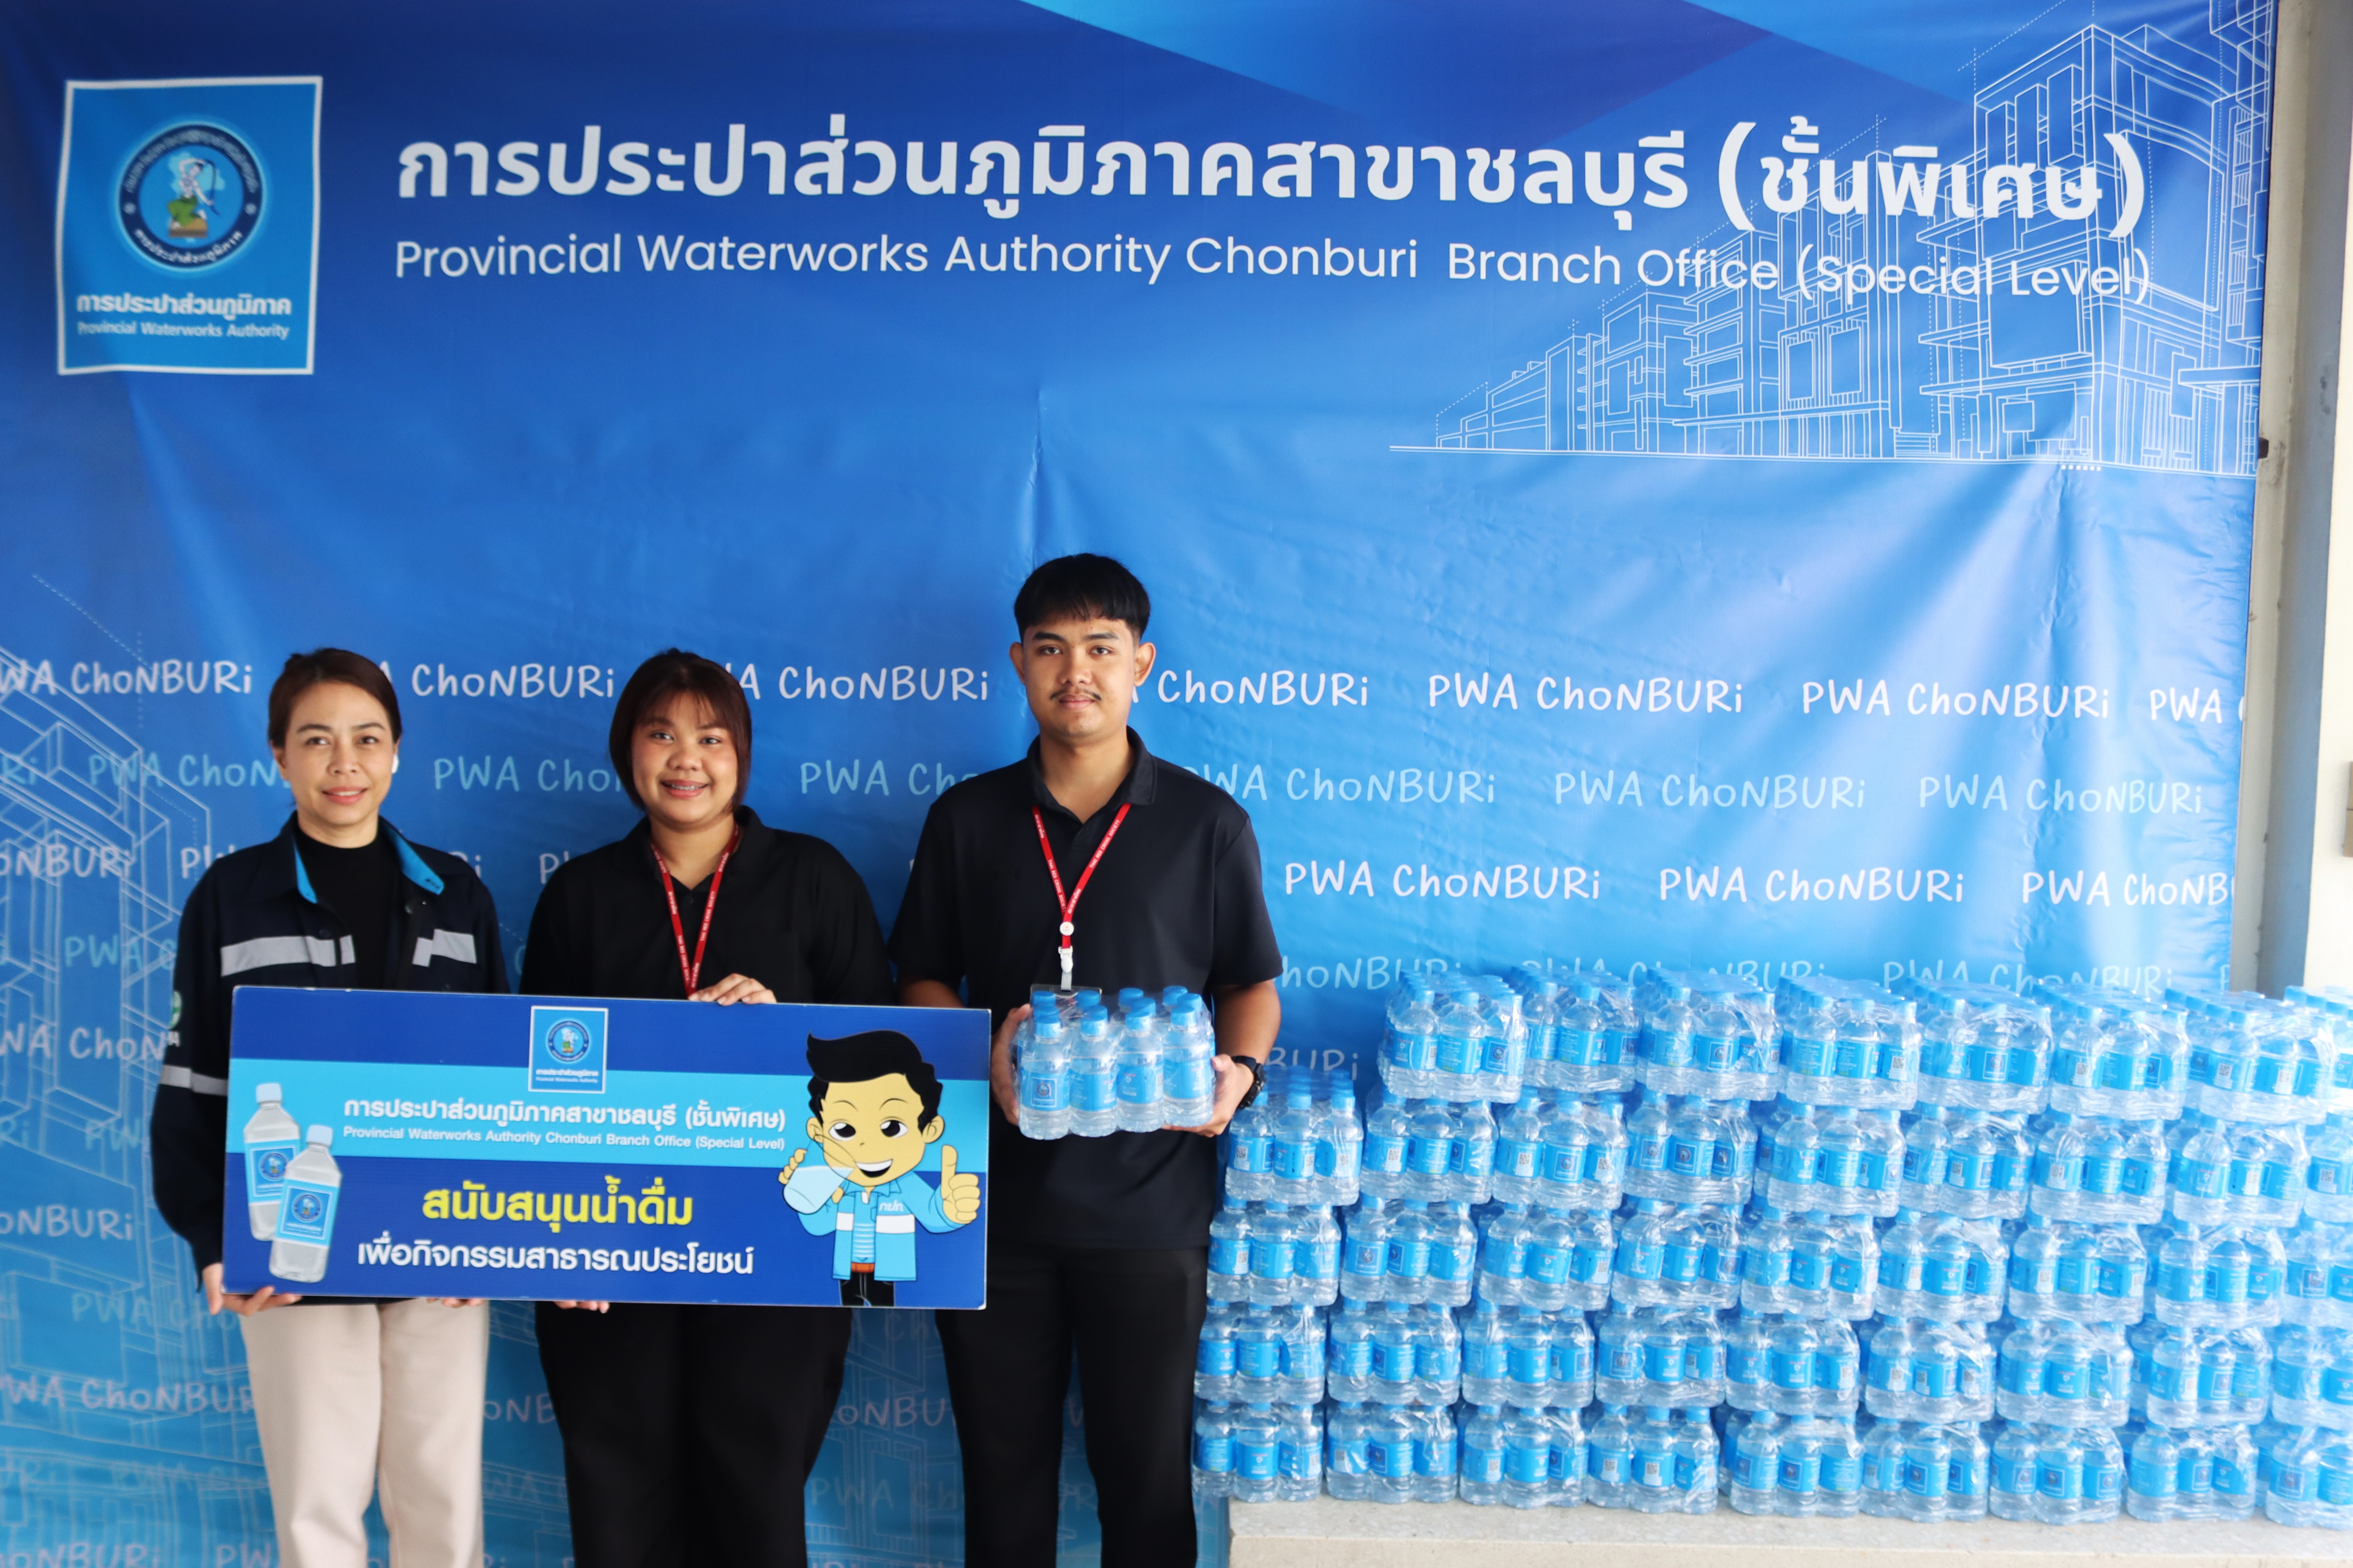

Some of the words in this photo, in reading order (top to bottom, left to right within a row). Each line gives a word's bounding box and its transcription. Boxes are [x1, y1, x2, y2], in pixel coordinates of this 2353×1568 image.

[398, 114, 1688, 231] การประปาส่วนภูมิภาคสาขาชลบุรี
[1718, 115, 2145, 239] (ชั้นพิเศษ)
[396, 232, 622, 279] Provincial
[637, 234, 928, 273] Waterworks
[943, 234, 1171, 285] Authority
[1186, 236, 1418, 279] Chonburi
[1449, 242, 1621, 285] Branch
[1638, 248, 1779, 291] Office
[1798, 243, 1993, 306] (Special
[2011, 248, 2150, 305] Level)
[77, 292, 292, 321] การประปาส่วนภูมิภาค
[77, 320, 137, 335] Provincial
[140, 321, 223, 337] Waterworks
[226, 323, 290, 340] Authority
[0, 658, 57, 696] WA
[71, 659, 253, 694] ChoNBURi
[412, 663, 614, 698] ChoNBURi
[779, 665, 988, 701] ChoNBURi
[1157, 669, 1368, 706] ChoNBURi
[1429, 672, 1518, 710] PWA
[1536, 676, 1743, 714] ChoNBURi
[1802, 678, 1891, 716] PWA
[1907, 682, 2109, 718] ChoNBURi
[2150, 687, 2222, 724] PWA
[88, 751, 163, 787] PWA
[178, 754, 291, 789] ChoN
[434, 755, 520, 791] PWA
[800, 759, 890, 796] PWA
[1184, 763, 1267, 802] WA
[1286, 768, 1495, 804] ChoNBURi
[1555, 770, 1643, 807] PWA
[1661, 774, 1866, 809] ChoNBURi
[1920, 774, 2008, 811] PWA
[2026, 778, 2202, 814] ChoNBURi
[1108, 819, 1120, 837] SOCIETY
[1285, 860, 1374, 897] PWA
[1393, 864, 1600, 900] ChoNBURi
[1659, 866, 1748, 902] PWA
[1765, 868, 1964, 902] ChoNBURi
[2023, 870, 2110, 907] PWA
[2124, 872, 2234, 906] ChoNB
[64, 935, 145, 971] PWA
[1281, 955, 1461, 990] hoNB
[0, 1023, 52, 1059] WA
[69, 1026, 169, 1061] ChoN
[344, 1098, 677, 1131] การประปาส่วนภูมิภาคสาขาชลบุรี
[685, 1100, 785, 1131] (ชั้นพิเศษ)
[85, 1118, 142, 1151] PW
[343, 1125, 404, 1140] Provincial
[408, 1127, 481, 1142] Waterworks
[485, 1129, 541, 1146] Authority
[545, 1130, 602, 1145] Chonburi
[606, 1133, 650, 1146] Branch
[654, 1134, 691, 1148] Office
[695, 1136, 744, 1151] (Special
[748, 1137, 785, 1151] Level)
[0, 1204, 133, 1241] oNBURi
[422, 1175, 693, 1233] สนับสนุนน้ำดื่ม
[358, 1231, 754, 1274] เพื่อกิจกรรมสาธารณประโยชน์
[2, 1374, 66, 1409] WA
[81, 1378, 254, 1414] ChoNBUR
[216, 1543, 272, 1568] PW
